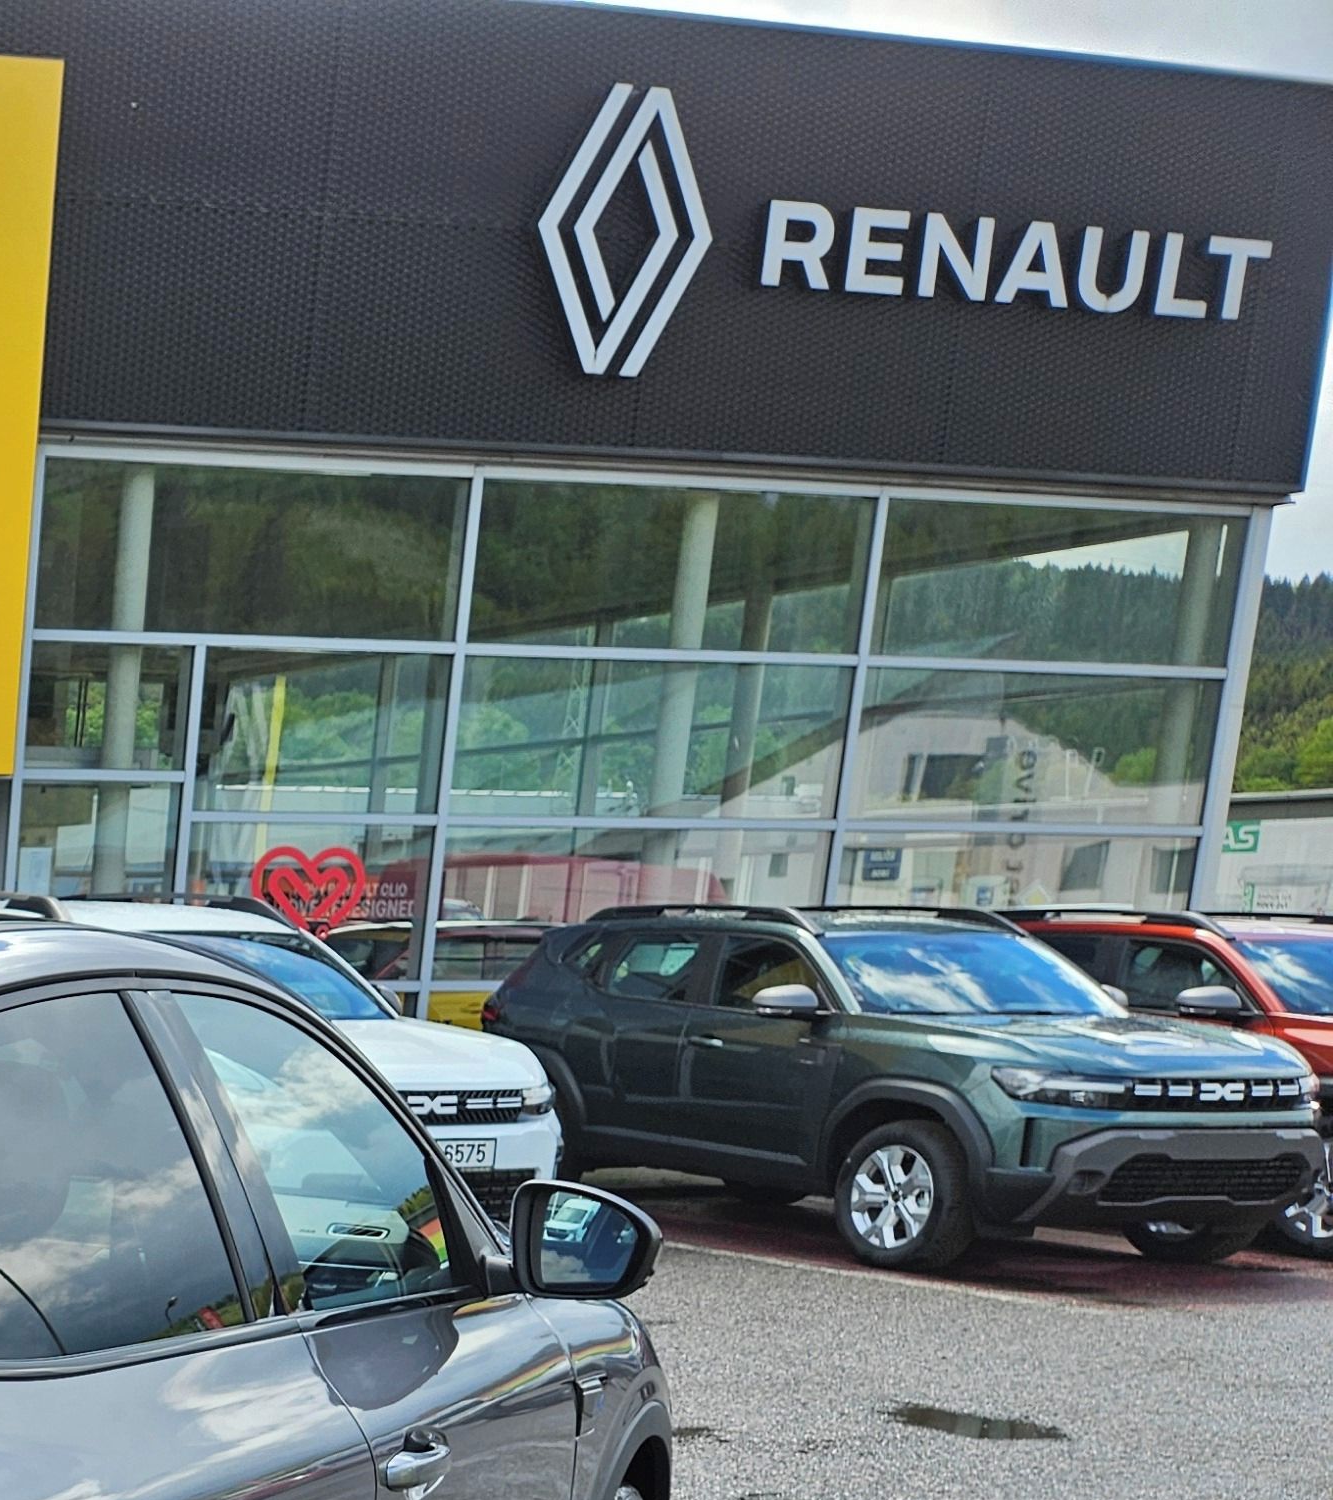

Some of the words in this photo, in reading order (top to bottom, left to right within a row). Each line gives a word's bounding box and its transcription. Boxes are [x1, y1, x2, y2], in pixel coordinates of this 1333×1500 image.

[760, 199, 1273, 320] RENAULT
[380, 883, 408, 897] CLIO
[444, 1143, 486, 1163] 6575
